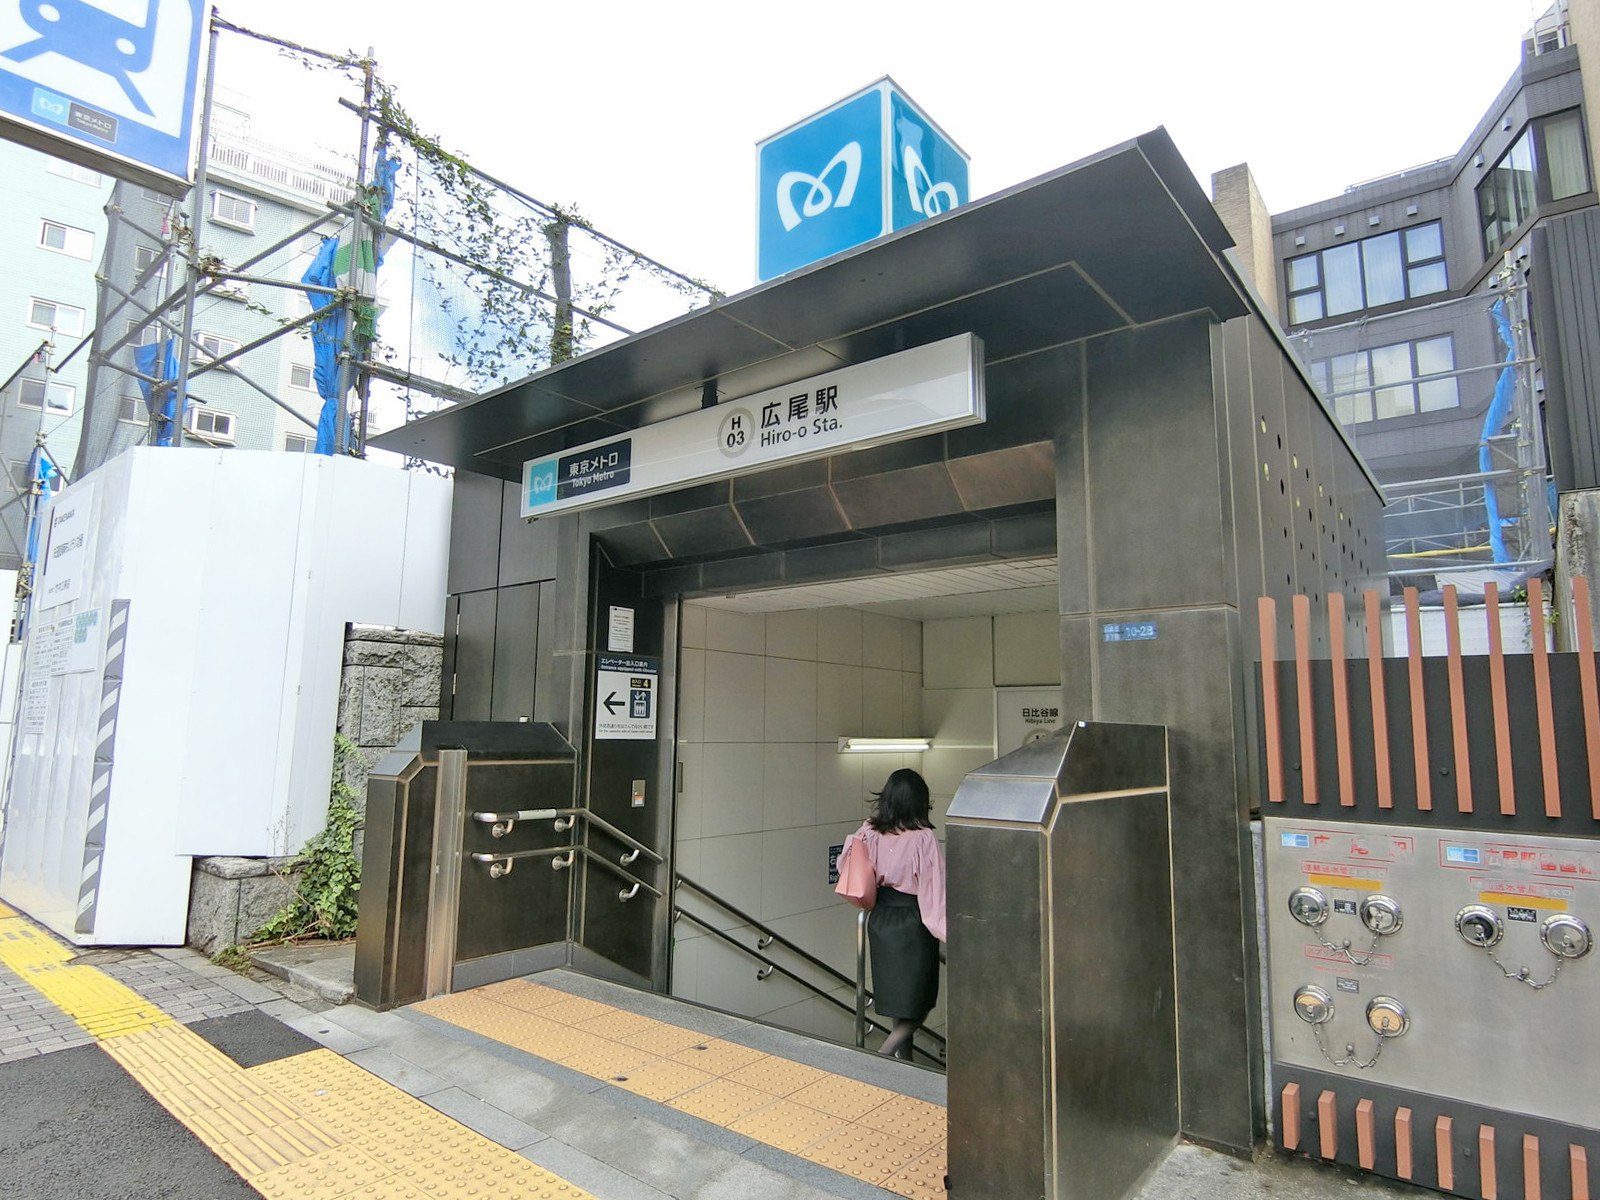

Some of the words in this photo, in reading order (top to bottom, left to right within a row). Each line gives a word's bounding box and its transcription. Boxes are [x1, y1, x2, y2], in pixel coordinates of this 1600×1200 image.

[761, 385, 839, 429] 広尾駅
[731, 416, 741, 431] H
[759, 424, 808, 447] Hiro-o
[812, 417, 843, 436] Sta.
[726, 430, 745, 448] 03
[568, 452, 619, 477] 東京メトロ
[571, 471, 592, 488] Tokyo
[592, 468, 615, 484] Metro
[643, 679, 648, 688] 4
[1022, 708, 1059, 717] 日比谷線
